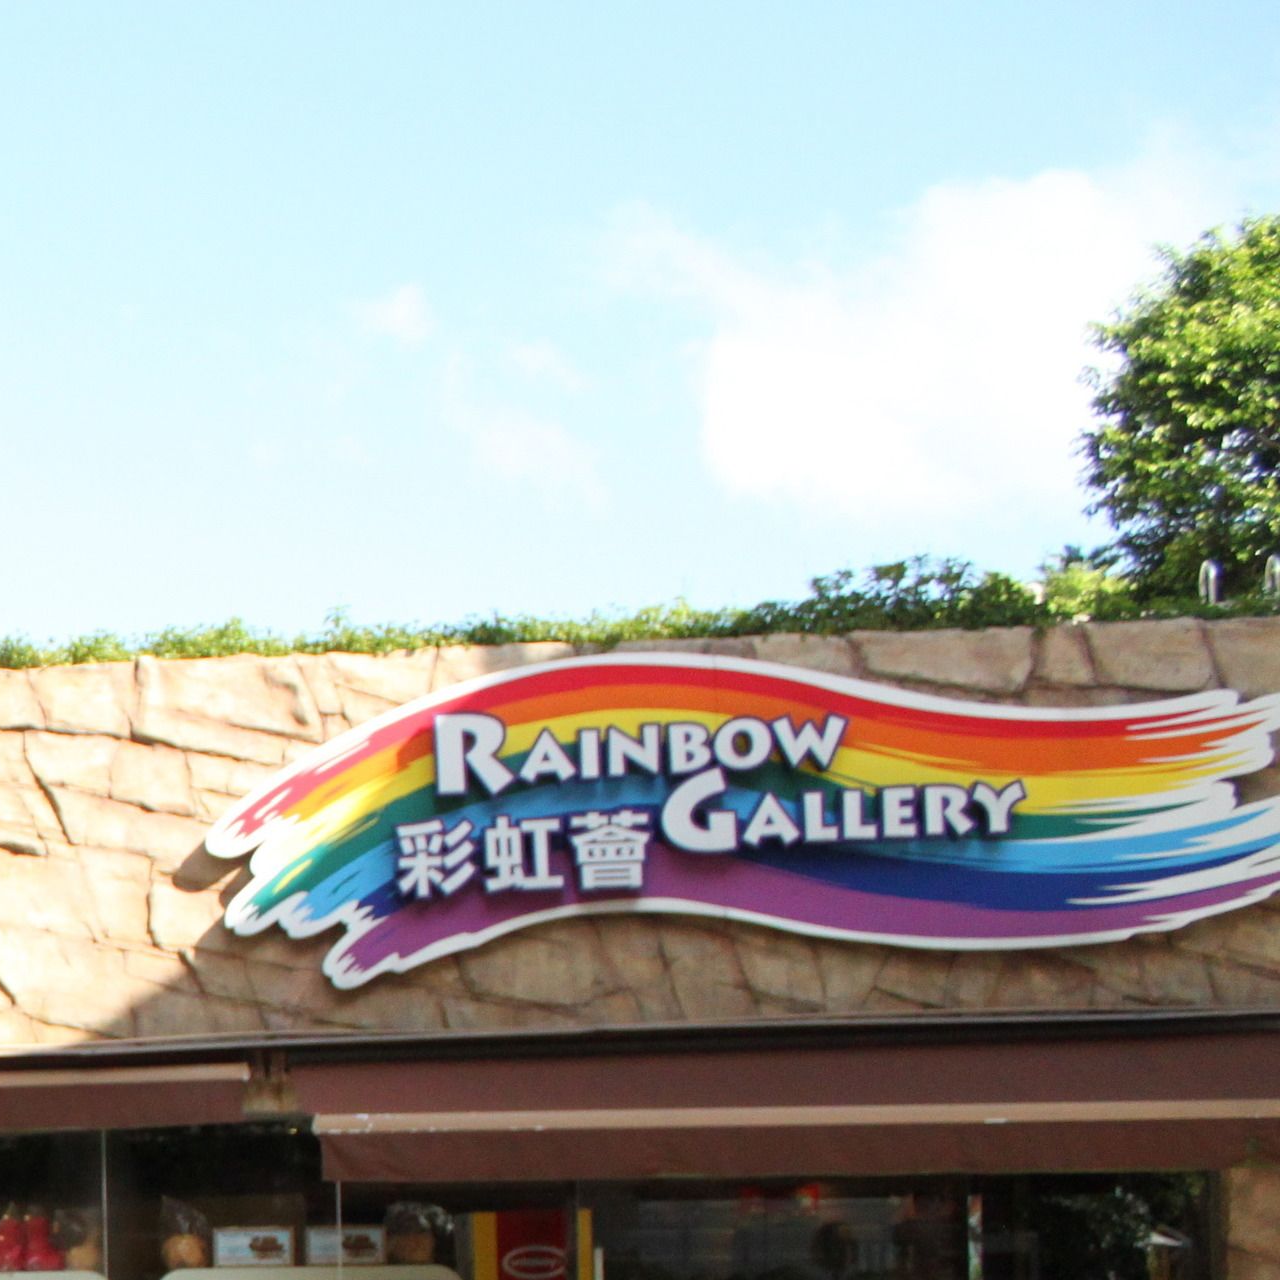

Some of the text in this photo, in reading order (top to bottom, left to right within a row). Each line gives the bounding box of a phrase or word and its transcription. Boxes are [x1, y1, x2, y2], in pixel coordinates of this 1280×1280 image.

[434, 711, 848, 797] RAINBOW
[661, 767, 1026, 853] GALLERY
[395, 809, 650, 899] 彩虹薈
